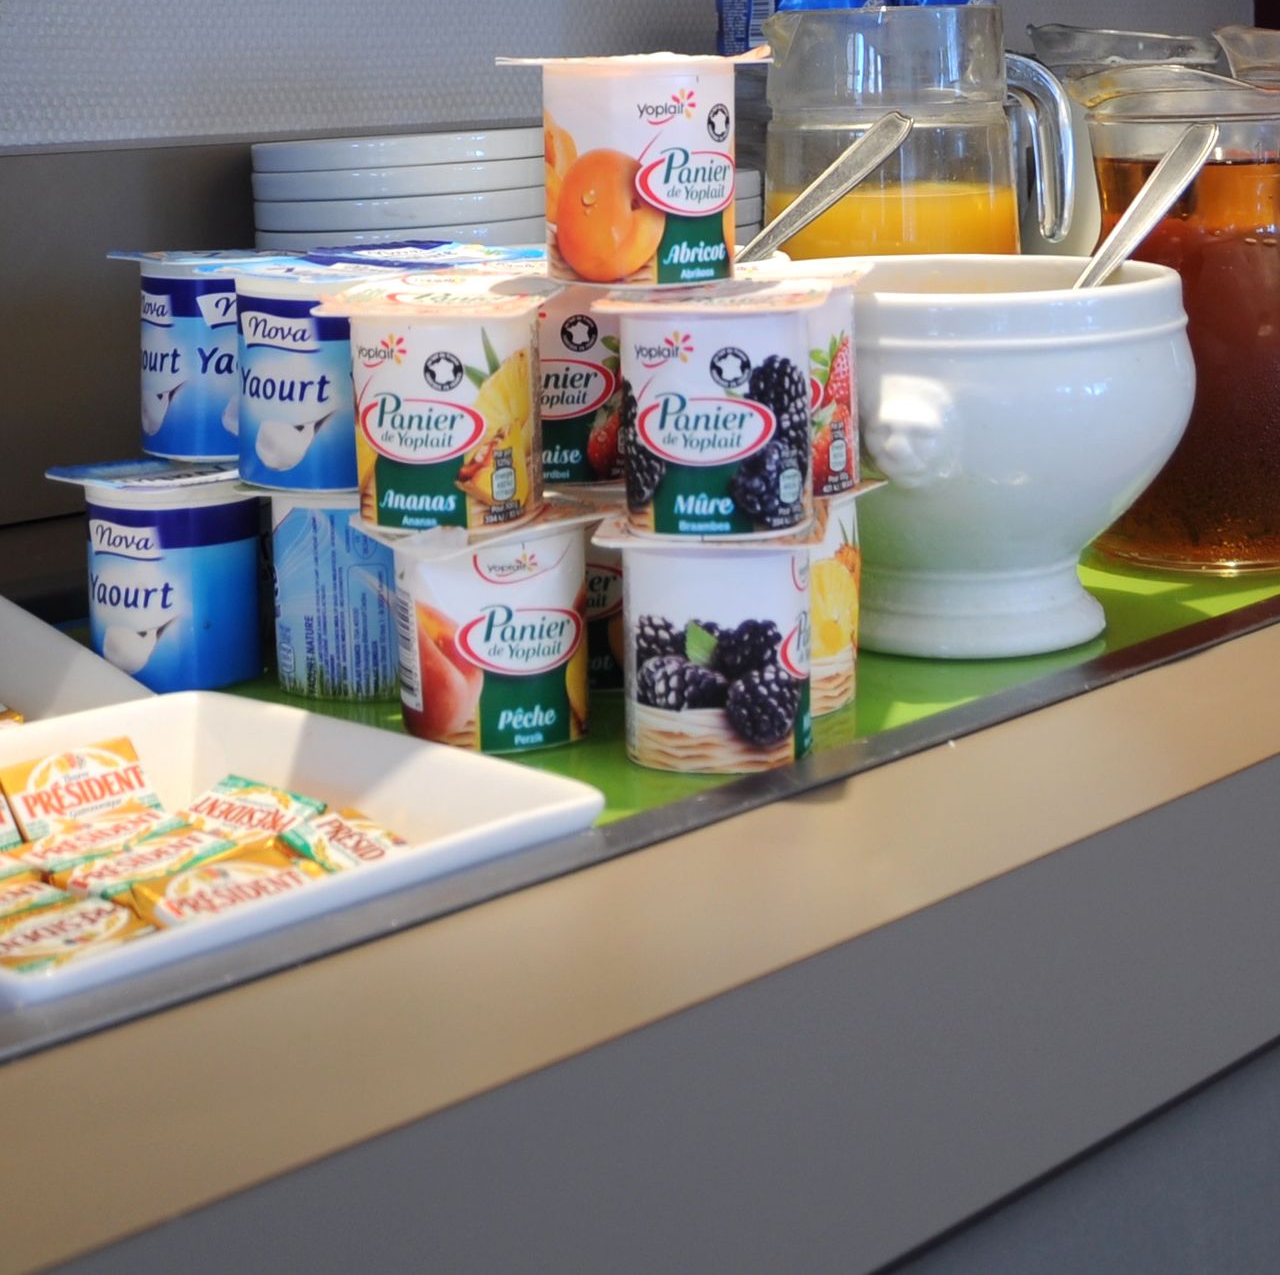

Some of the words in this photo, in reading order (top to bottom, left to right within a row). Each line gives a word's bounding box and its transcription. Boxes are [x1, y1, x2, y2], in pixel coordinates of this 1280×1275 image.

[660, 146, 731, 185] Panier
[666, 186, 682, 199] de
[683, 184, 726, 204] Yoplait
[662, 240, 727, 266] Abricot
[142, 294, 169, 318] ova
[248, 315, 312, 344] Nova
[142, 348, 182, 375] ourt
[242, 366, 332, 404] Yaourt
[542, 365, 599, 390] nier
[373, 391, 465, 431] Panier
[540, 390, 589, 410] oplait
[655, 391, 755, 432] Panier
[380, 430, 395, 442] de
[397, 431, 454, 452] Yoplait
[662, 432, 678, 445] de
[681, 432, 743, 453] Yoplait
[541, 444, 583, 465] aise
[379, 489, 458, 513] Ananas
[673, 492, 735, 516] Mûre
[95, 524, 155, 551] Nova
[89, 572, 175, 611] Yaourt
[480, 604, 570, 644] Panier
[487, 645, 504, 658] de
[507, 640, 563, 663] Yoplait
[497, 703, 557, 731] Pêche
[22, 763, 148, 820] PRÉSIDENT
